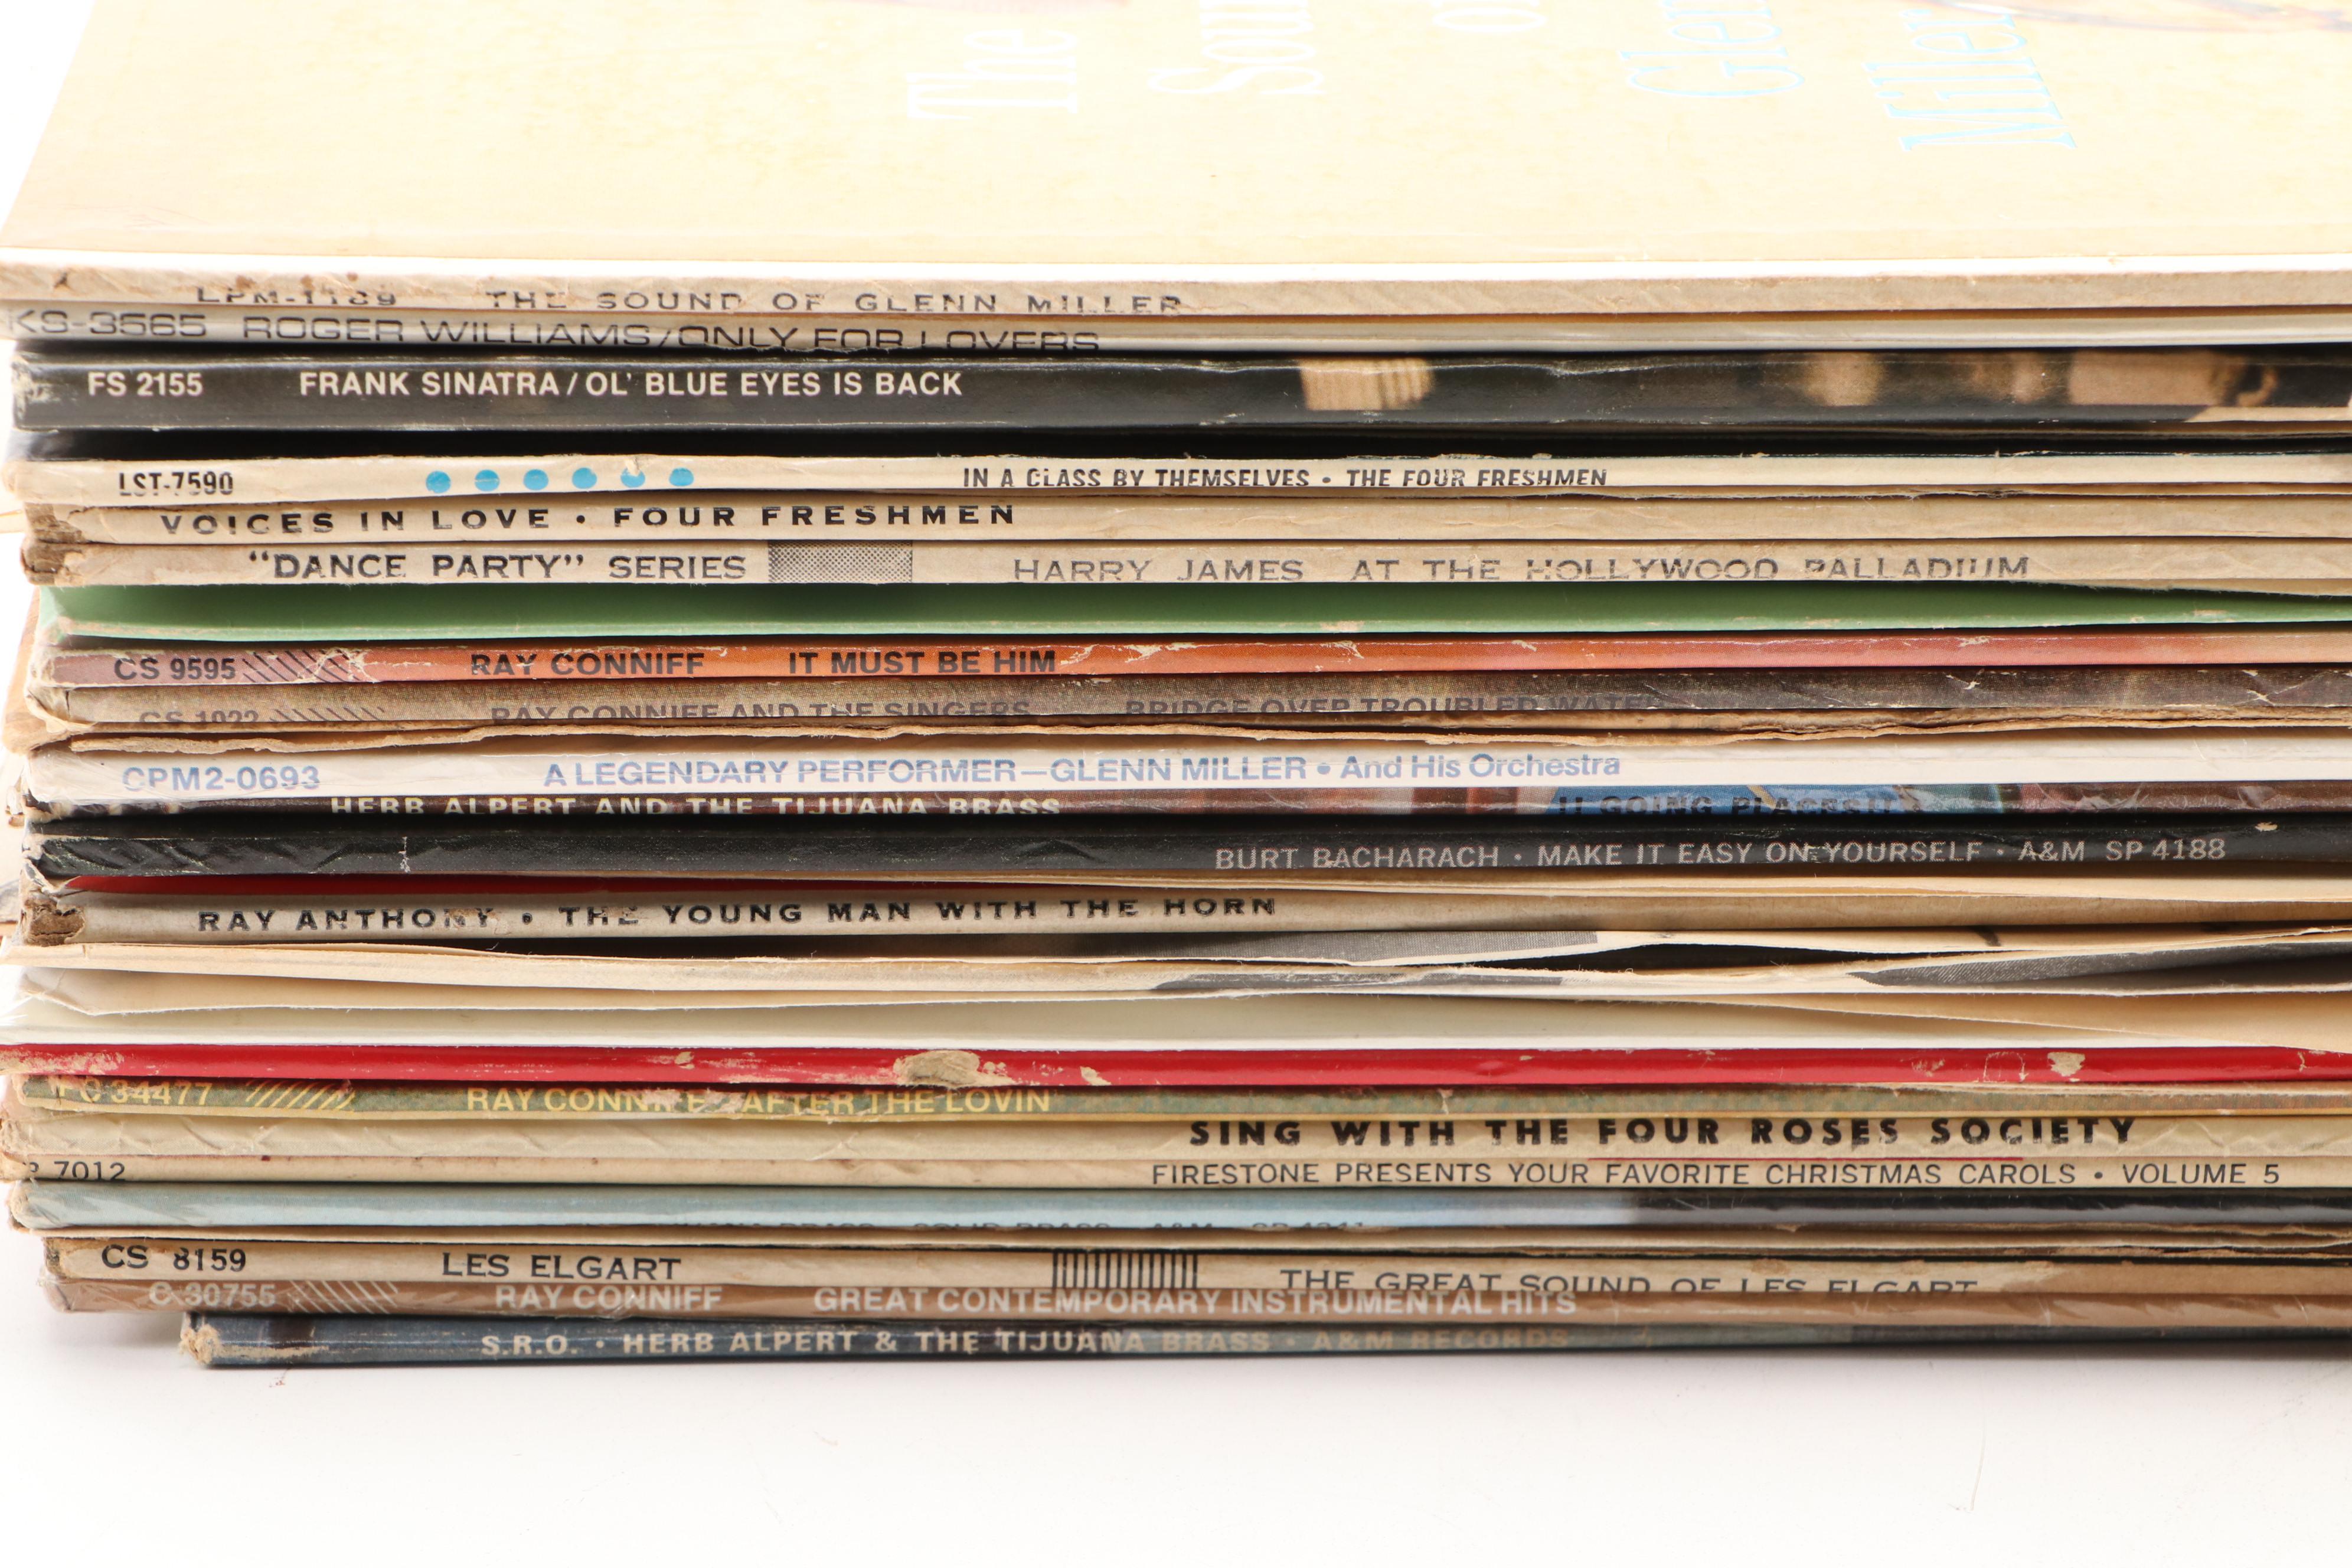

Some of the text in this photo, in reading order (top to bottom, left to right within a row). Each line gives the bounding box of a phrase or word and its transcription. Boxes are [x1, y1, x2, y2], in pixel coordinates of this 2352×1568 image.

[486, 291, 567, 308] THE
[596, 292, 741, 311] SOUND
[773, 292, 825, 311] OF
[855, 293, 997, 312] GLENN
[1027, 295, 1182, 314] MILLER
[11, 310, 207, 337] KS-3565
[243, 316, 404, 341] ROGER
[814, 328, 903, 348] FOR
[89, 372, 126, 396] FS
[138, 372, 203, 396] 2155
[300, 372, 409, 396] FRANK
[646, 372, 727, 396] BLUE
[741, 372, 820, 396] EYES
[834, 372, 862, 396] IS
[876, 372, 962, 396] BACK
[963, 468, 988, 487] IN
[1001, 469, 1014, 487] A
[1027, 468, 1100, 487] CLASS
[1114, 469, 1144, 487] BY
[1156, 469, 1309, 487] THEMSELVES
[1347, 469, 1390, 487] THE
[1403, 469, 1466, 487] FOUR
[1477, 469, 1608, 486] FRESHMEN
[161, 505, 1014, 534] VOICES IN LOVE FOUR FRESHMEN
[609, 555, 746, 580] SERIES
[1014, 558, 1151, 582] HARRY
[1178, 559, 1304, 581] JAMES
[1350, 559, 1400, 581] AT
[1423, 559, 1501, 581] THE
[1526, 558, 1778, 580] HOLLYWOOD
[1805, 557, 2030, 579] PALLADIUM
[114, 650, 1056, 680] CS 9595 RAY CONNIFF IT MUST BE HIM
[122, 765, 320, 791] CPM2-0693
[544, 763, 567, 787] A
[575, 760, 788, 785] LEGENDARY
[1182, 756, 1306, 780] MILLER
[1340, 755, 1402, 779] And
[1411, 754, 1460, 778] His
[1469, 752, 1621, 777] Orchestra
[331, 798, 1060, 815] HERB ALPERT AND THE TIJUANA BRASS
[1215, 838, 2226, 870] BURT BACHARACH MAKE IT EASY ON YOURSELF A&M SP 4188
[198, 897, 1275, 931] RAY ANTHONY THE YOUNG MAN WITH THE HORN
[467, 1087, 531, 1111] RAY
[864, 1090, 935, 1113] THE
[947, 1090, 1050, 1113] LOVIN
[1190, 1118, 2134, 1146] SING WITH THE FOUR ROSES SOCIETY
[1153, 1163, 1318, 1184] FIRESTONE
[1336, 1163, 1491, 1183] PRESENTS
[1508, 1163, 1588, 1184] YOUR
[1607, 1164, 1749, 1184] FAVORITE
[1766, 1164, 1941, 1184] CHRISTMAS
[1959, 1164, 2075, 1184] CAROLS
[2122, 1163, 2246, 1184] VOLUME
[2263, 1163, 2281, 1184] 5
[102, 1245, 148, 1269] CS
[172, 1248, 246, 1272] 8159
[443, 1252, 508, 1276] LES
[531, 1254, 681, 1280] ELGART
[1280, 1269, 1354, 1289] THE
[1376, 1272, 1500, 1291] GREAT
[185, 1282, 276, 1308] 30755
[496, 1285, 563, 1309] RAY
[573, 1286, 723, 1311] CONNIFF
[814, 1287, 926, 1312] GREAT
[937, 1288, 1218, 1315] CONTEMPORARY
[1231, 1290, 1491, 1315] INSTRUMENTAL
[1501, 1290, 1576, 1315] HITS
[481, 1329, 1569, 1356] S.R.O. HERB ALPERT & THE TIJUANA BRASS A&M RECORDS
